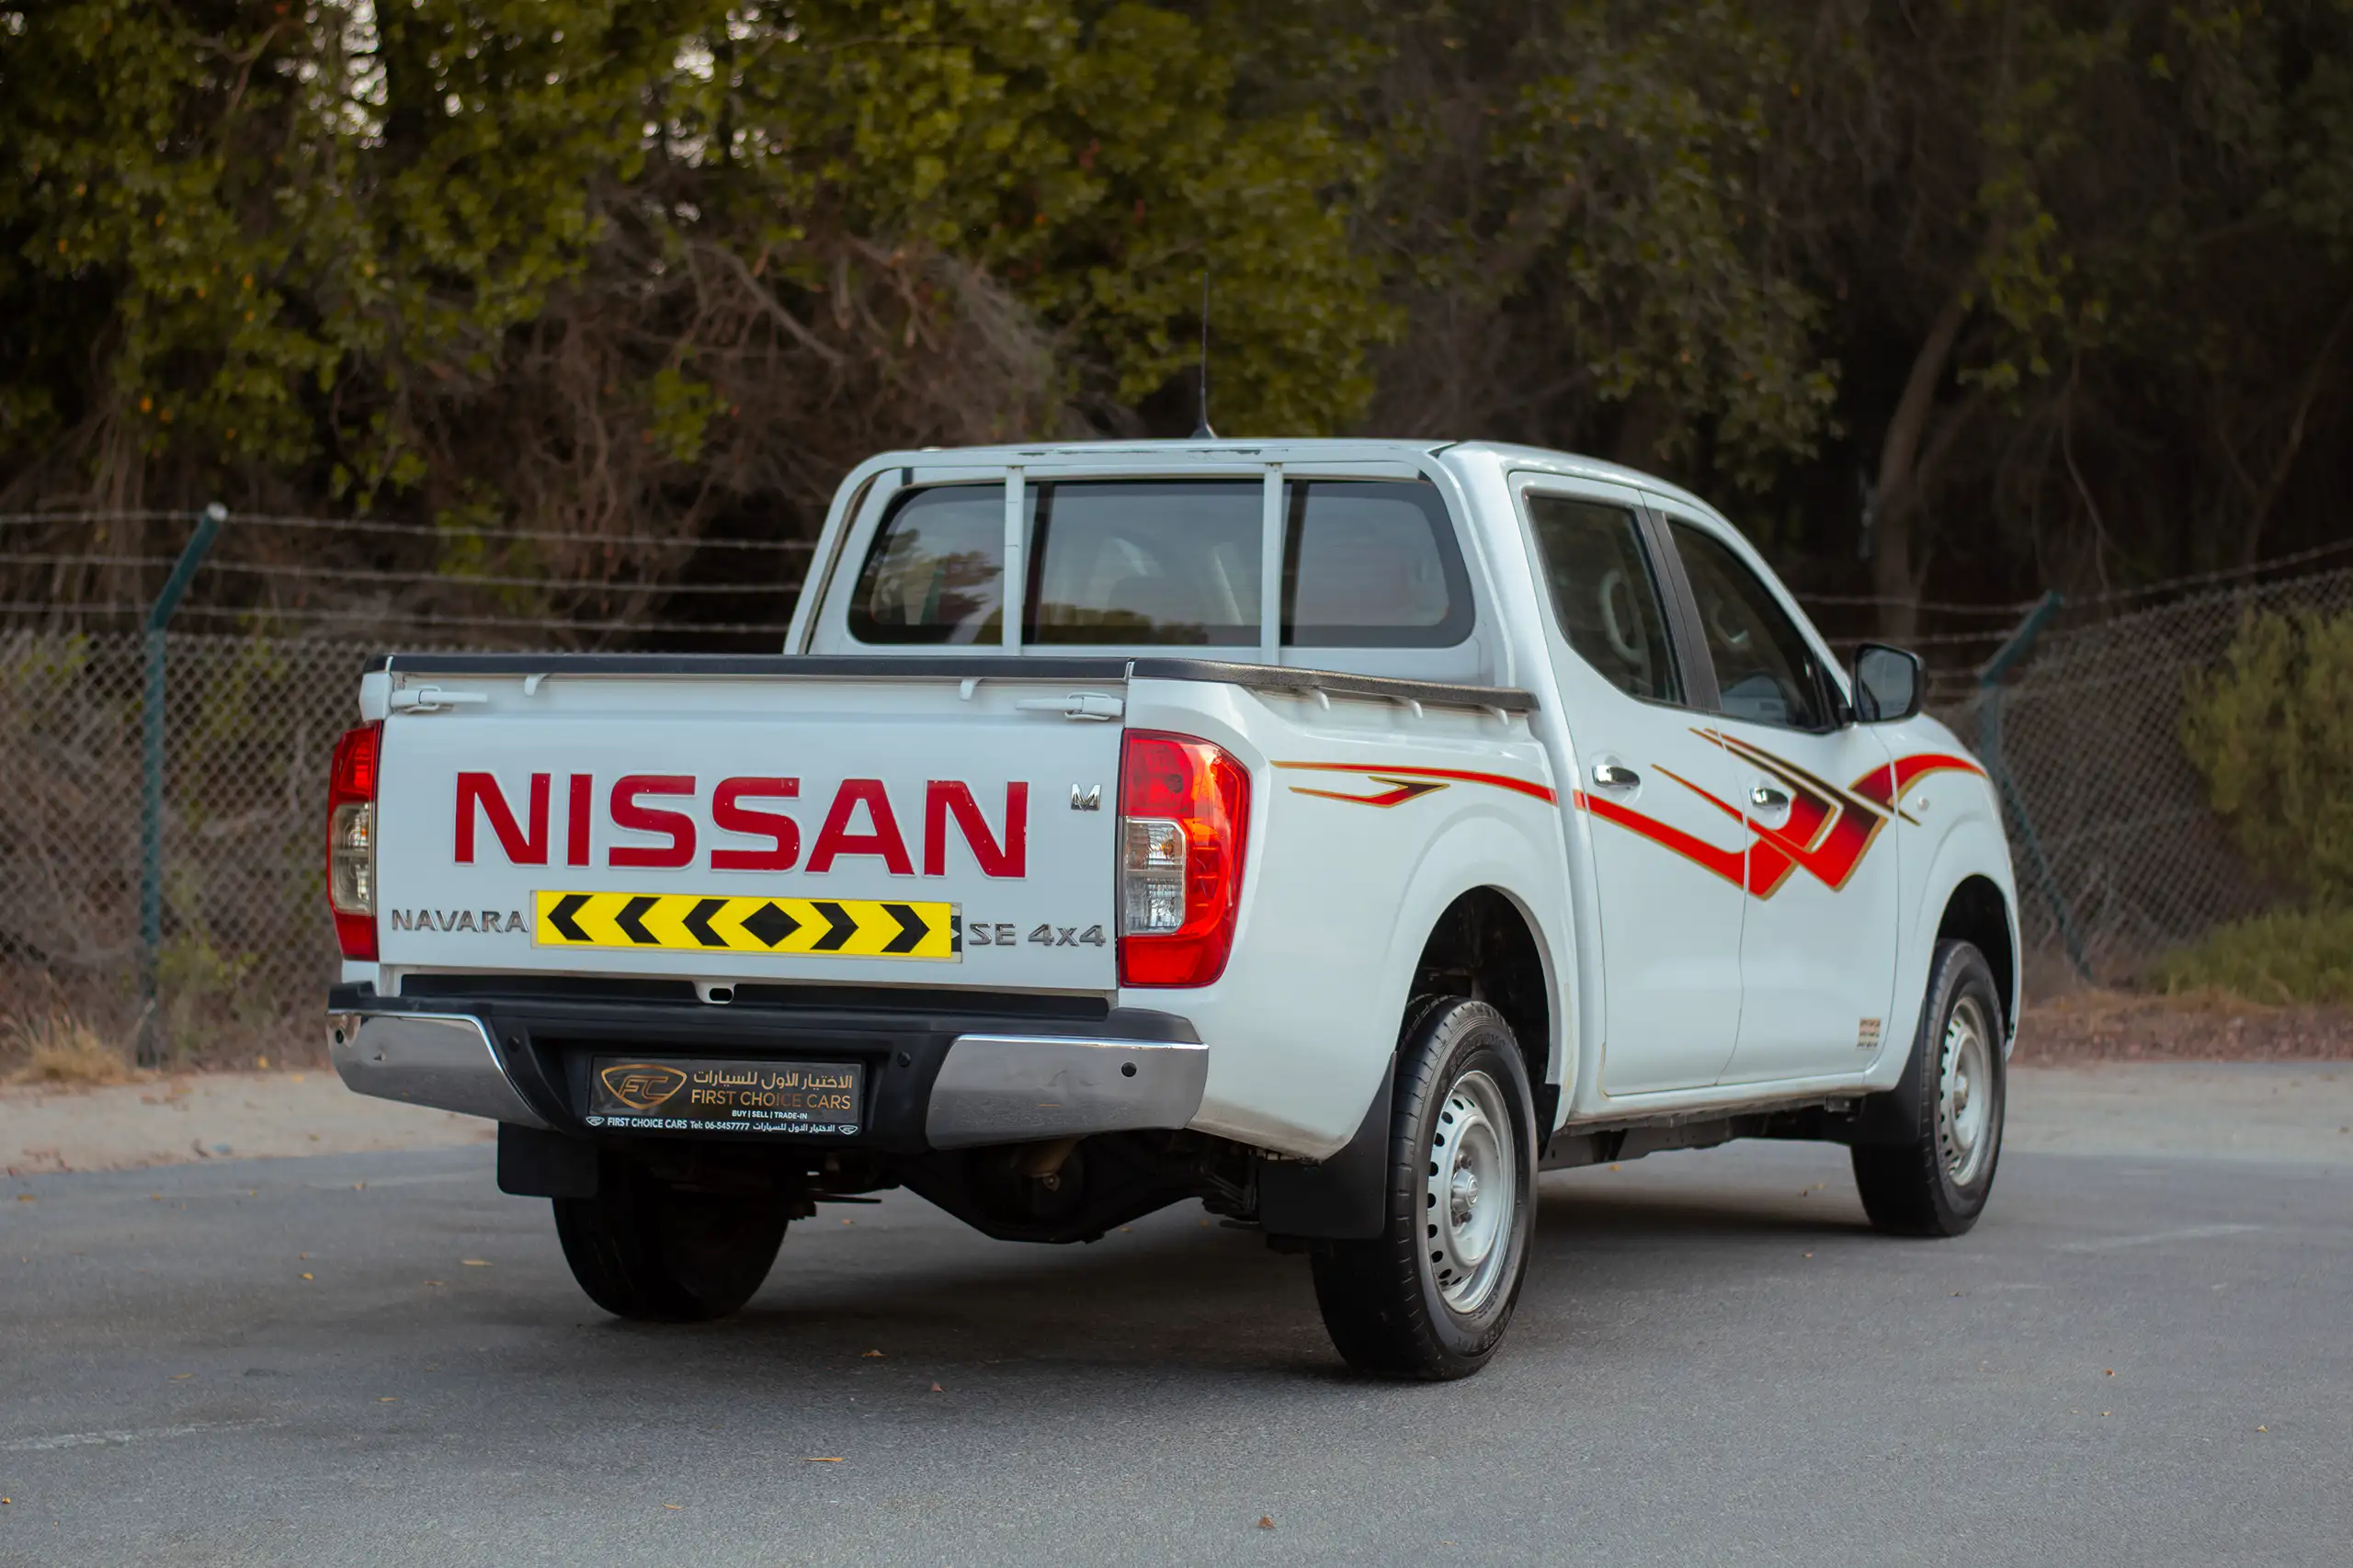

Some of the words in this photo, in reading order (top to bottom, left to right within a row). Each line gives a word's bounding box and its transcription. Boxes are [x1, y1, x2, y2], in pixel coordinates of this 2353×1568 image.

[1071, 783, 1101, 811] M
[453, 771, 1029, 879] NISSAN
[392, 909, 529, 933] NAVARA
[968, 923, 1017, 947] SE
[1028, 923, 1107, 948] 4x4
[693, 1070, 758, 1087] للسيارات
[761, 1071, 799, 1090] الأول
[801, 1073, 853, 1091] الاختيار
[691, 1089, 736, 1106] FIRST
[740, 1091, 803, 1108] CHOICE
[806, 1094, 851, 1109] CARS
[732, 1109, 747, 1118] BUY
[752, 1110, 769, 1119] SELL
[774, 1111, 808, 1119] TRADE-IN
[608, 1117, 631, 1127] FIRST
[631, 1118, 664, 1129] CHOICE
[665, 1119, 688, 1130] CARS
[690, 1120, 703, 1130] Tel:
[704, 1121, 750, 1131] 06-5457777
